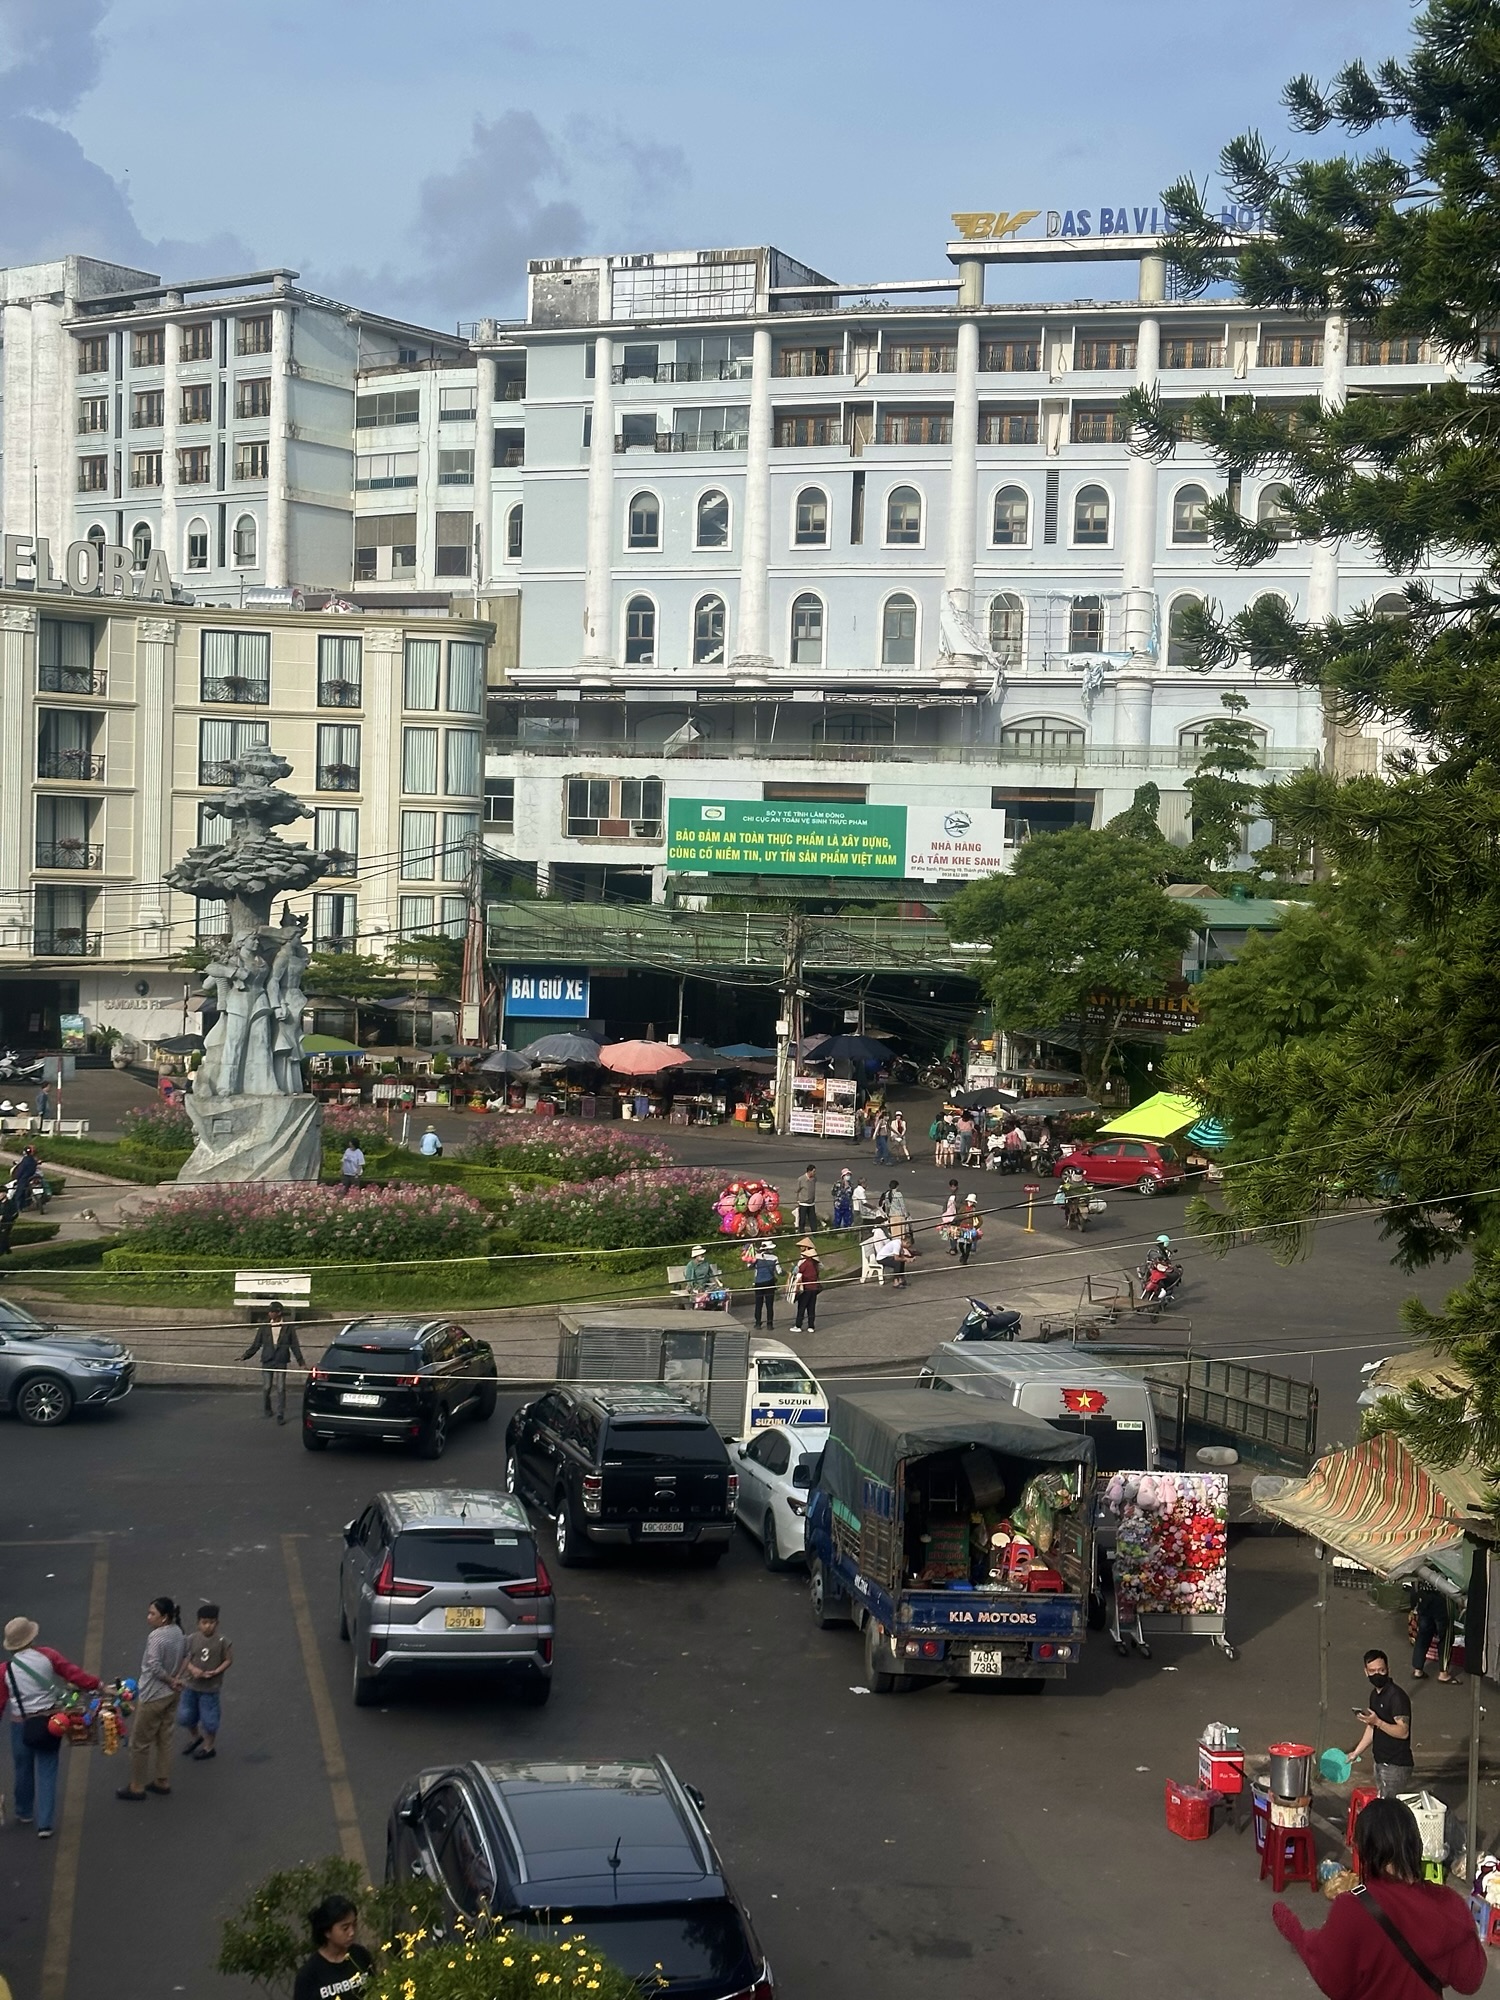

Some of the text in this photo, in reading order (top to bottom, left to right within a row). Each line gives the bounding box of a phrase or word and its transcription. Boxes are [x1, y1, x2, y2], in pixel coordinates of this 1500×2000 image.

[1047, 209, 1092, 238] DAS
[4, 534, 174, 601] FLORA
[675, 828, 892, 850] BẢO ĐẢM AN TOÀN THỰC PHẨM LÀ XÂY DỰNG,
[931, 841, 982, 852] NHÀ HÀNG
[669, 845, 897, 866] CỦNG CỐ NIỀM TIN, UY TÍN SẢN PHẨM VIỆT NAM
[911, 853, 924, 864] CÁ
[952, 856, 971, 865] KHE
[974, 857, 1000, 866] SANH
[512, 974, 583, 1000] BÃI GIỮ XE
[755, 1418, 786, 1426] SUZUKI
[456, 1609, 474, 1617] 50H
[949, 1611, 1037, 1624] KIA MOTORS
[200, 1647, 210, 1662] 3
[977, 1653, 995, 1662] 49X
[973, 1663, 998, 1673] 7383
